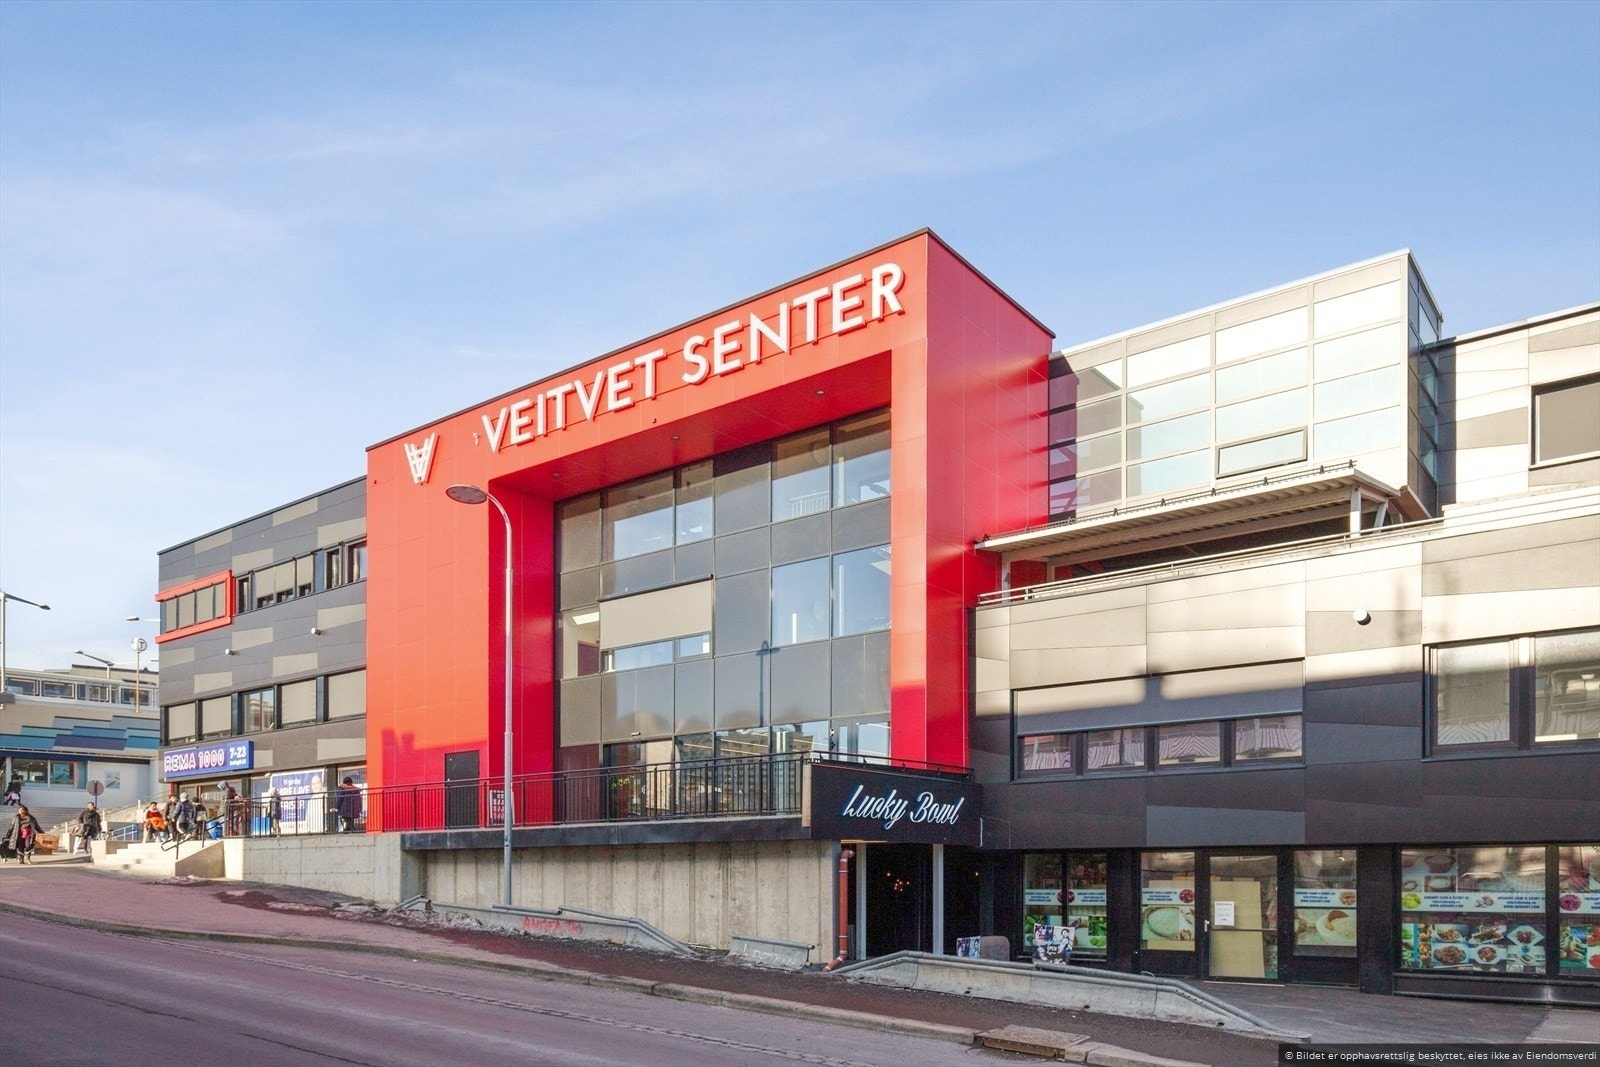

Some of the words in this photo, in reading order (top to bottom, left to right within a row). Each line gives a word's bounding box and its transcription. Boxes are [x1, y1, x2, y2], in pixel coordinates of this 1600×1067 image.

[481, 348, 667, 454] VEITVET
[681, 262, 906, 385] SENTER
[164, 753, 196, 772] REMA
[198, 749, 226, 768] 1000
[229, 746, 247, 759] 7-23
[842, 784, 909, 830] Lucky
[910, 791, 965, 825] Bowl
